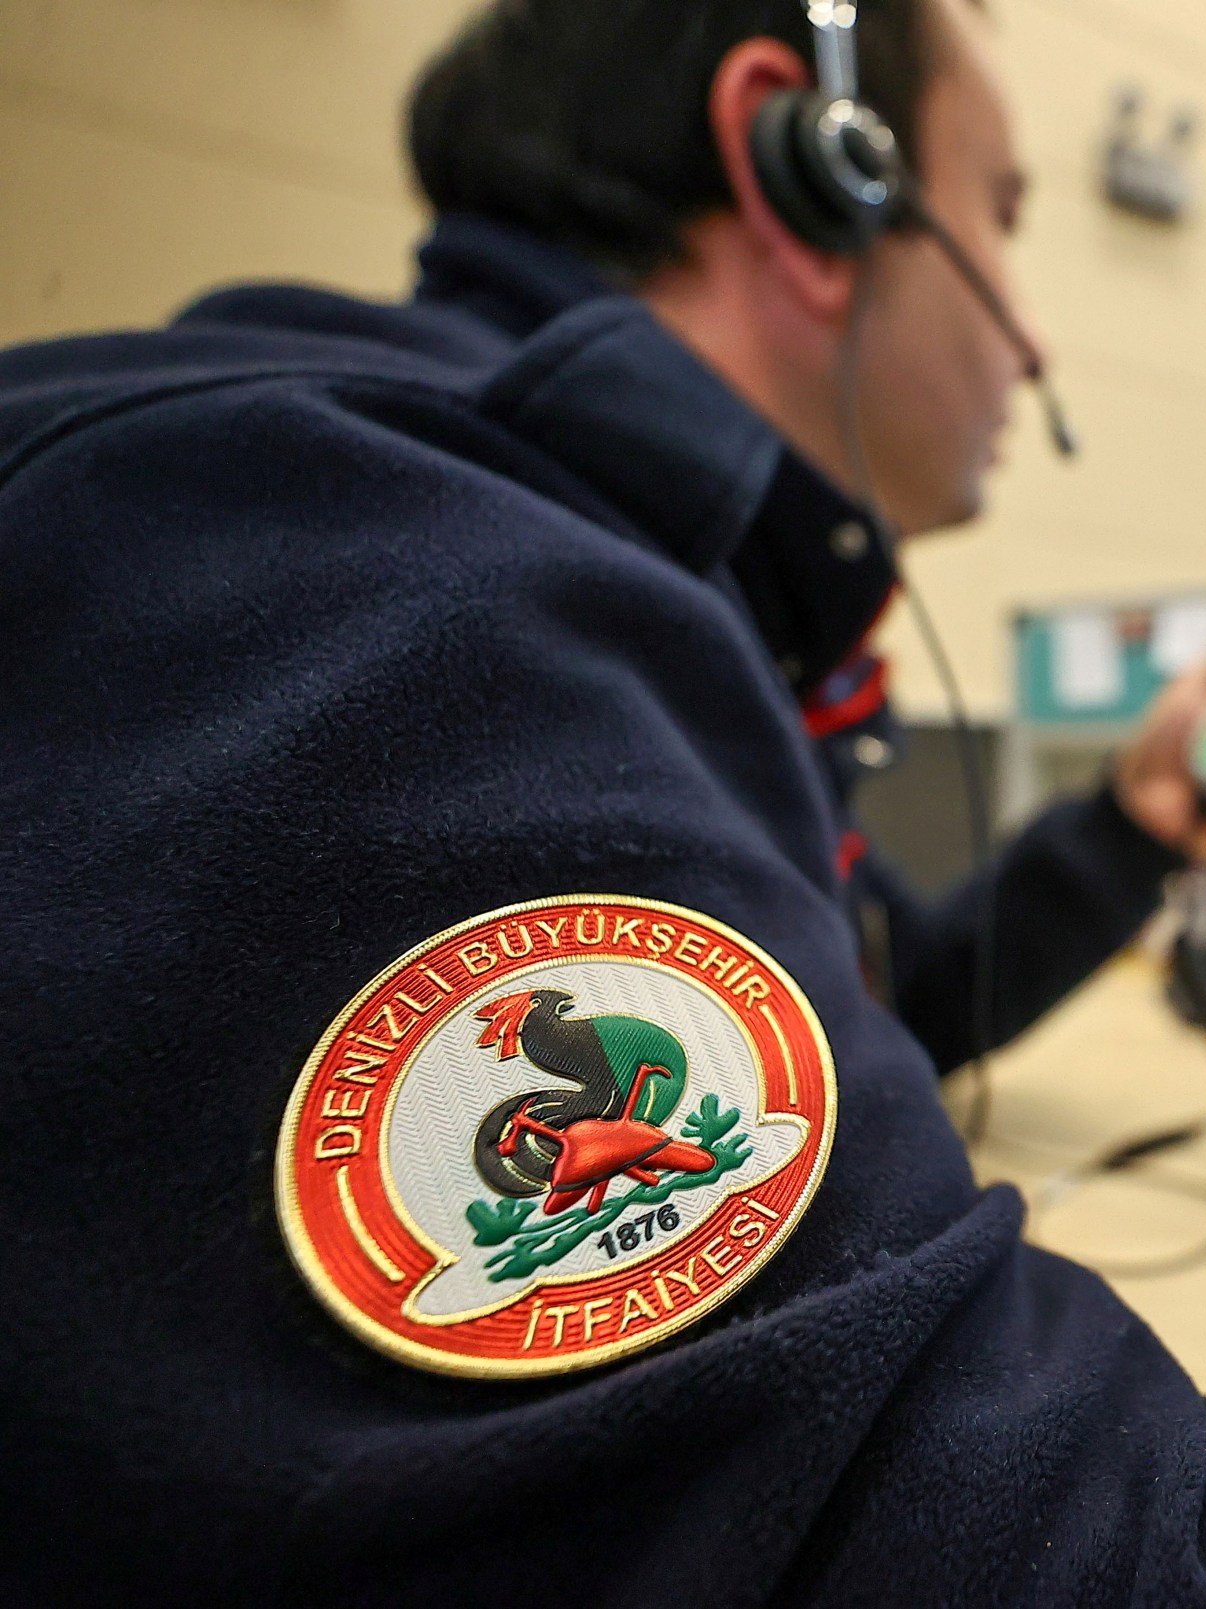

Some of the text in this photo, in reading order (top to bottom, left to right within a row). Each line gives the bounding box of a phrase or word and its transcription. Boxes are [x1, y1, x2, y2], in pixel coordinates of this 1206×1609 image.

[315, 908, 771, 1161] DENİZLİ BÜYÜKŞEHİR
[522, 1196, 779, 1351] İTFAİYESİ
[598, 1204, 681, 1260] 1876
